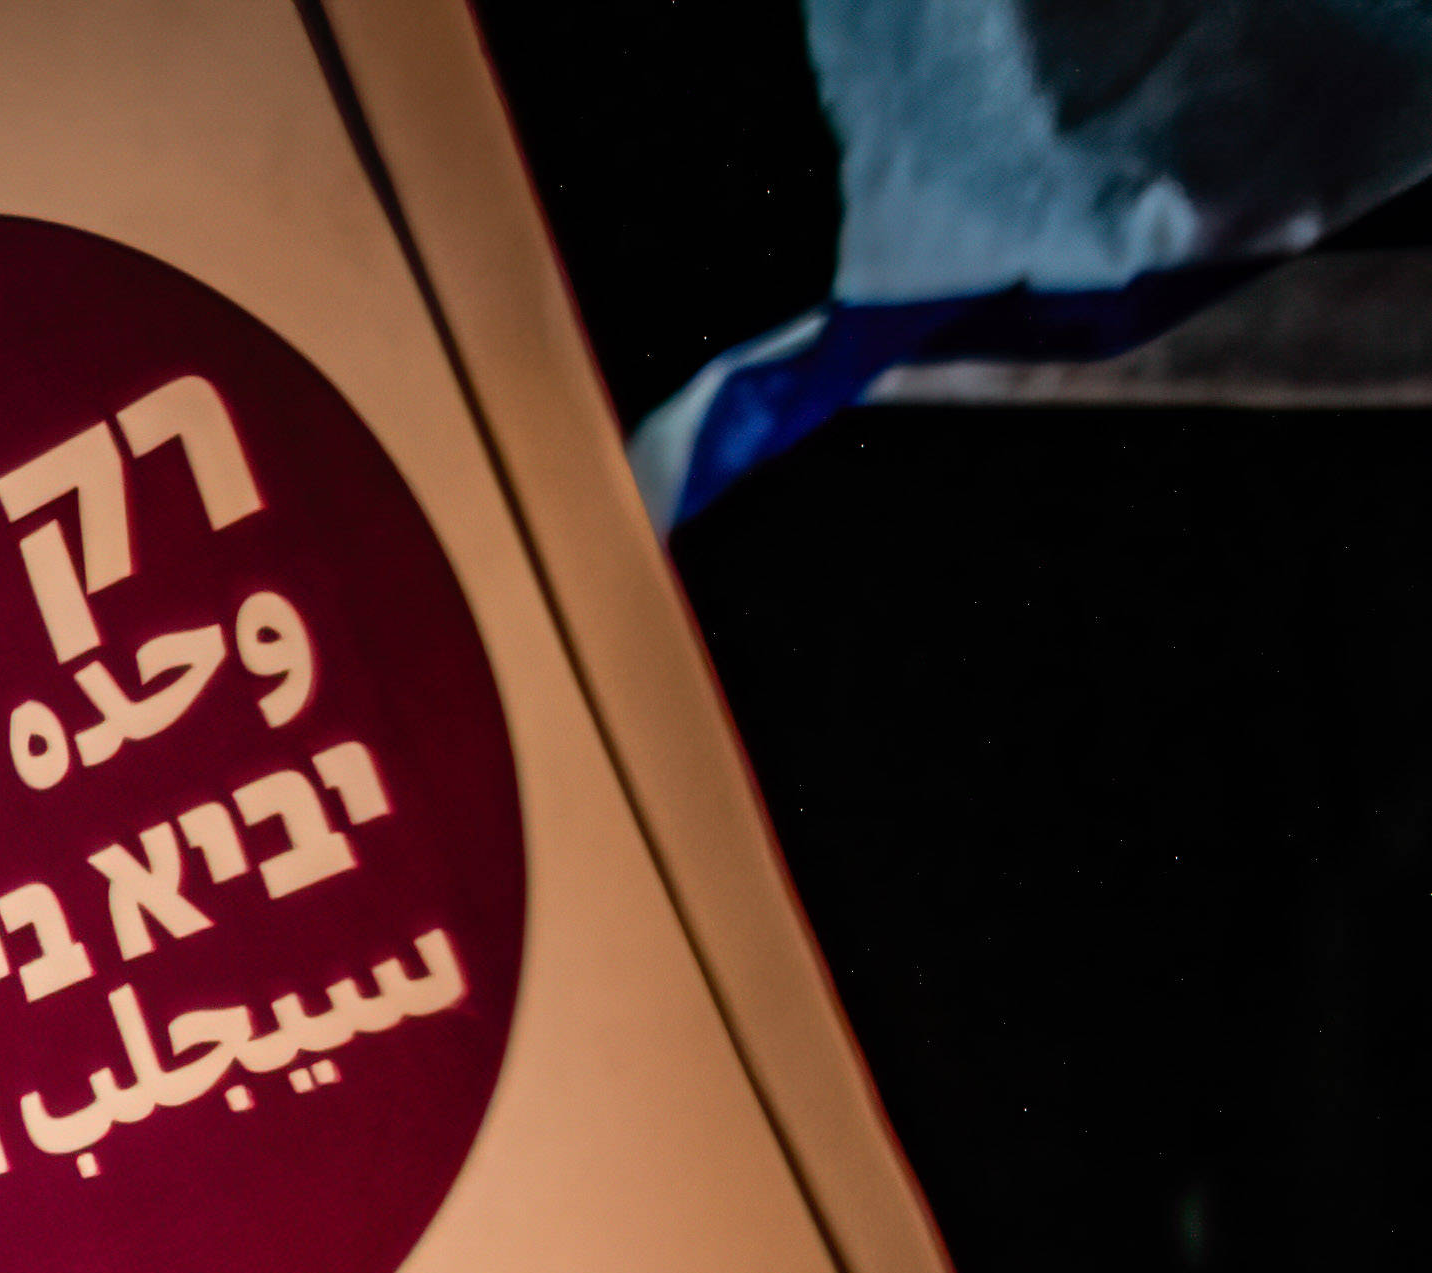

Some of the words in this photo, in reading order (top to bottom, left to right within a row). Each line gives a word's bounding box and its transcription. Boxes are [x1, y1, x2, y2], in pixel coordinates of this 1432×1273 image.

[8, 590, 316, 791] وحده
[87, 740, 393, 961] יביא
[19, 926, 469, 1179] سيجلب
